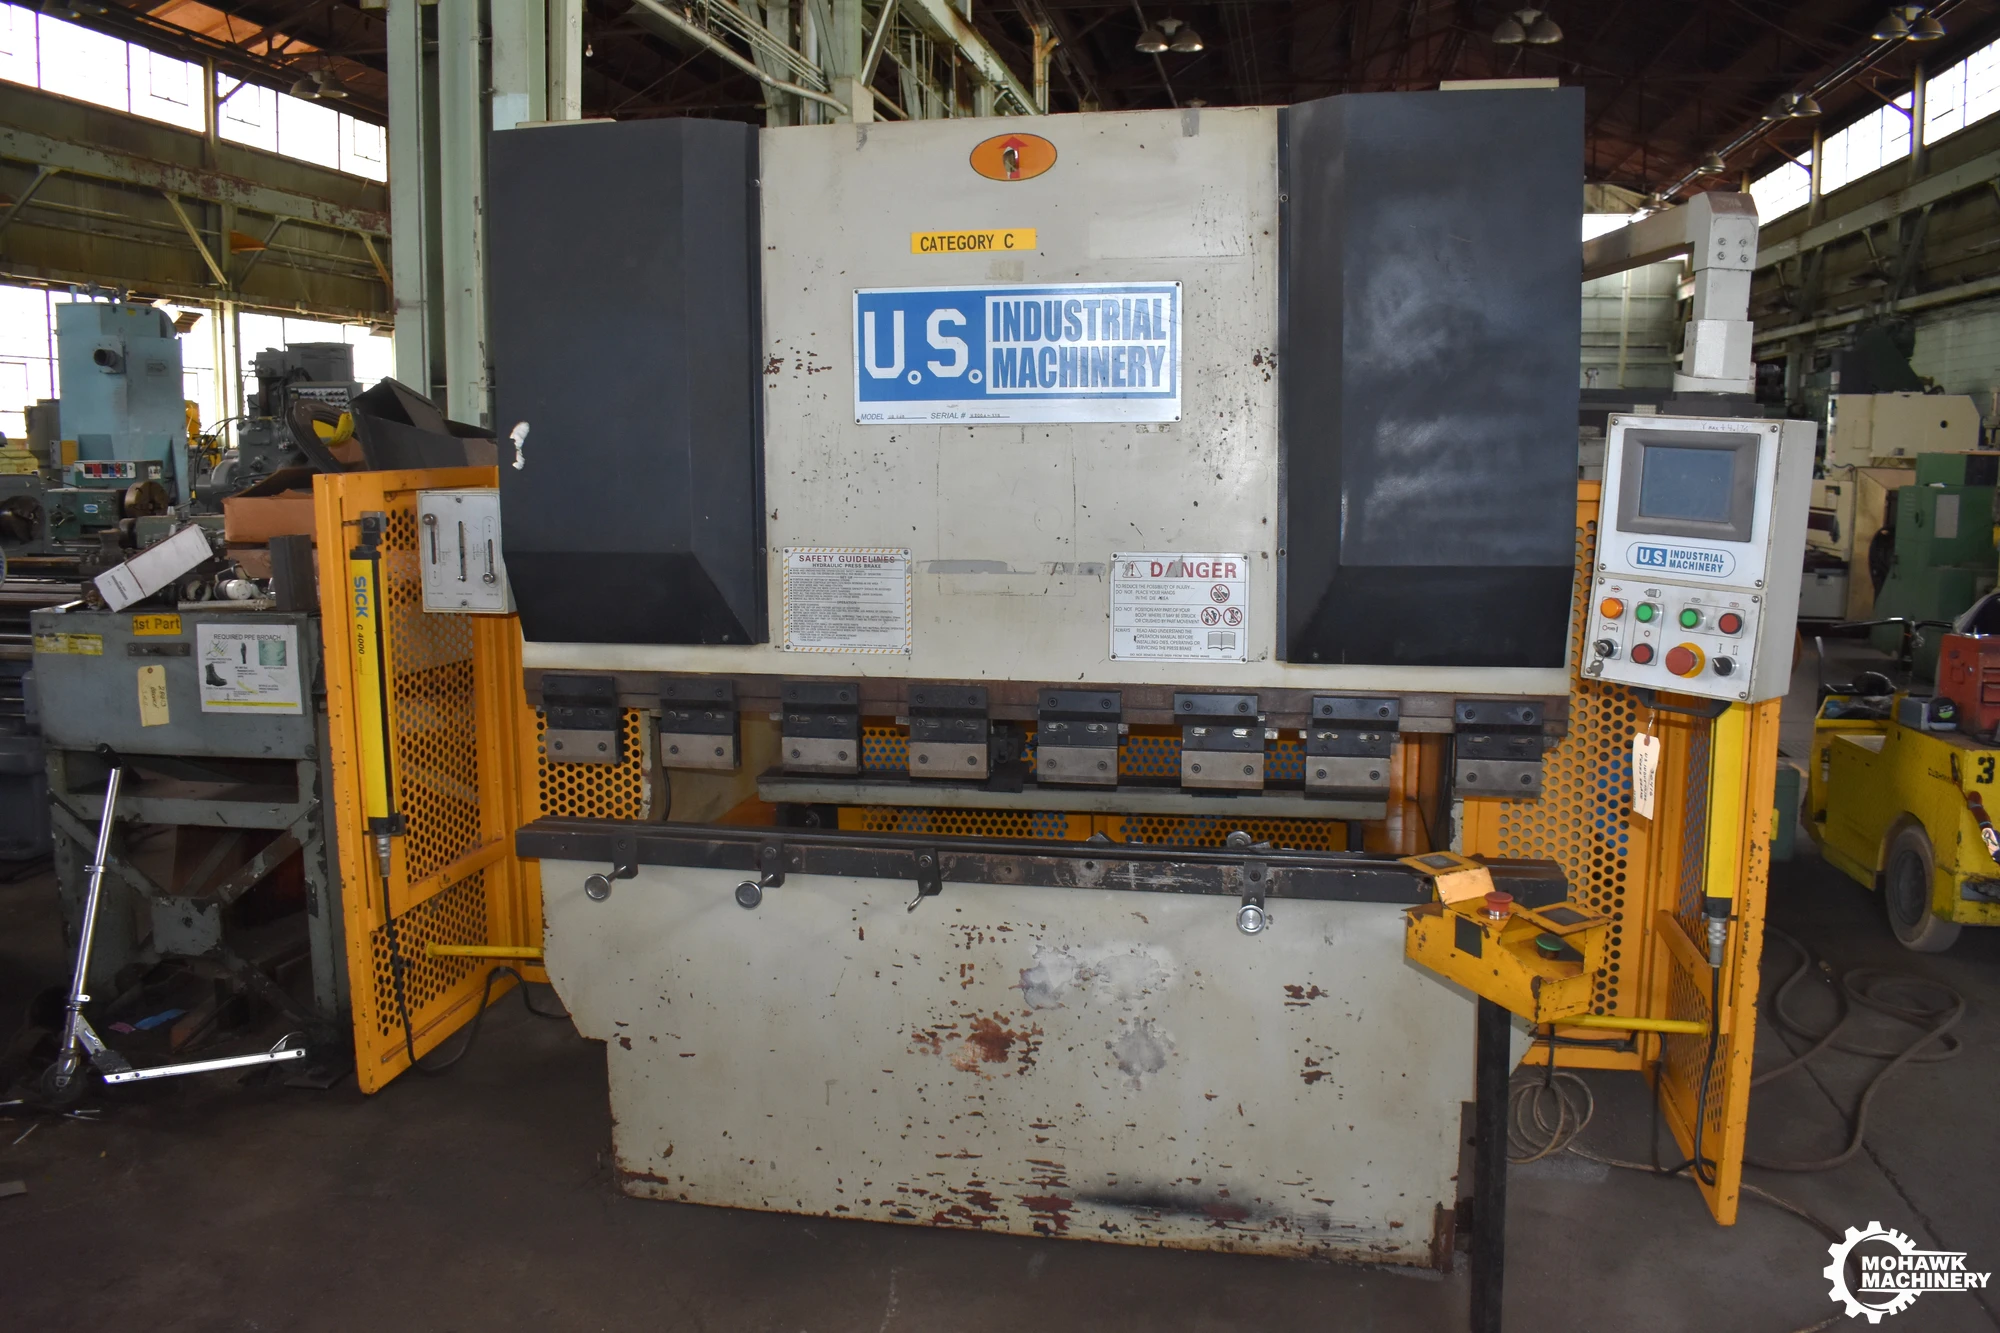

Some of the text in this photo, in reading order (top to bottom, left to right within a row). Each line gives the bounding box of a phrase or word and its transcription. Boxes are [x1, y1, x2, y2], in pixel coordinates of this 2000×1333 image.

[920, 234, 1014, 252] CATEGORY C
[992, 299, 1167, 342] INDUSTRIAL
[864, 308, 983, 386] U.S.
[992, 346, 1166, 388] MACHINERY
[1638, 548, 1666, 566] U.S.
[1669, 559, 1724, 573] MACHINERY
[1670, 550, 1724, 564] INDUSTRIAL
[354, 576, 369, 618] SICK
[134, 618, 180, 630] 1st Part
[1976, 756, 1995, 784] 3
